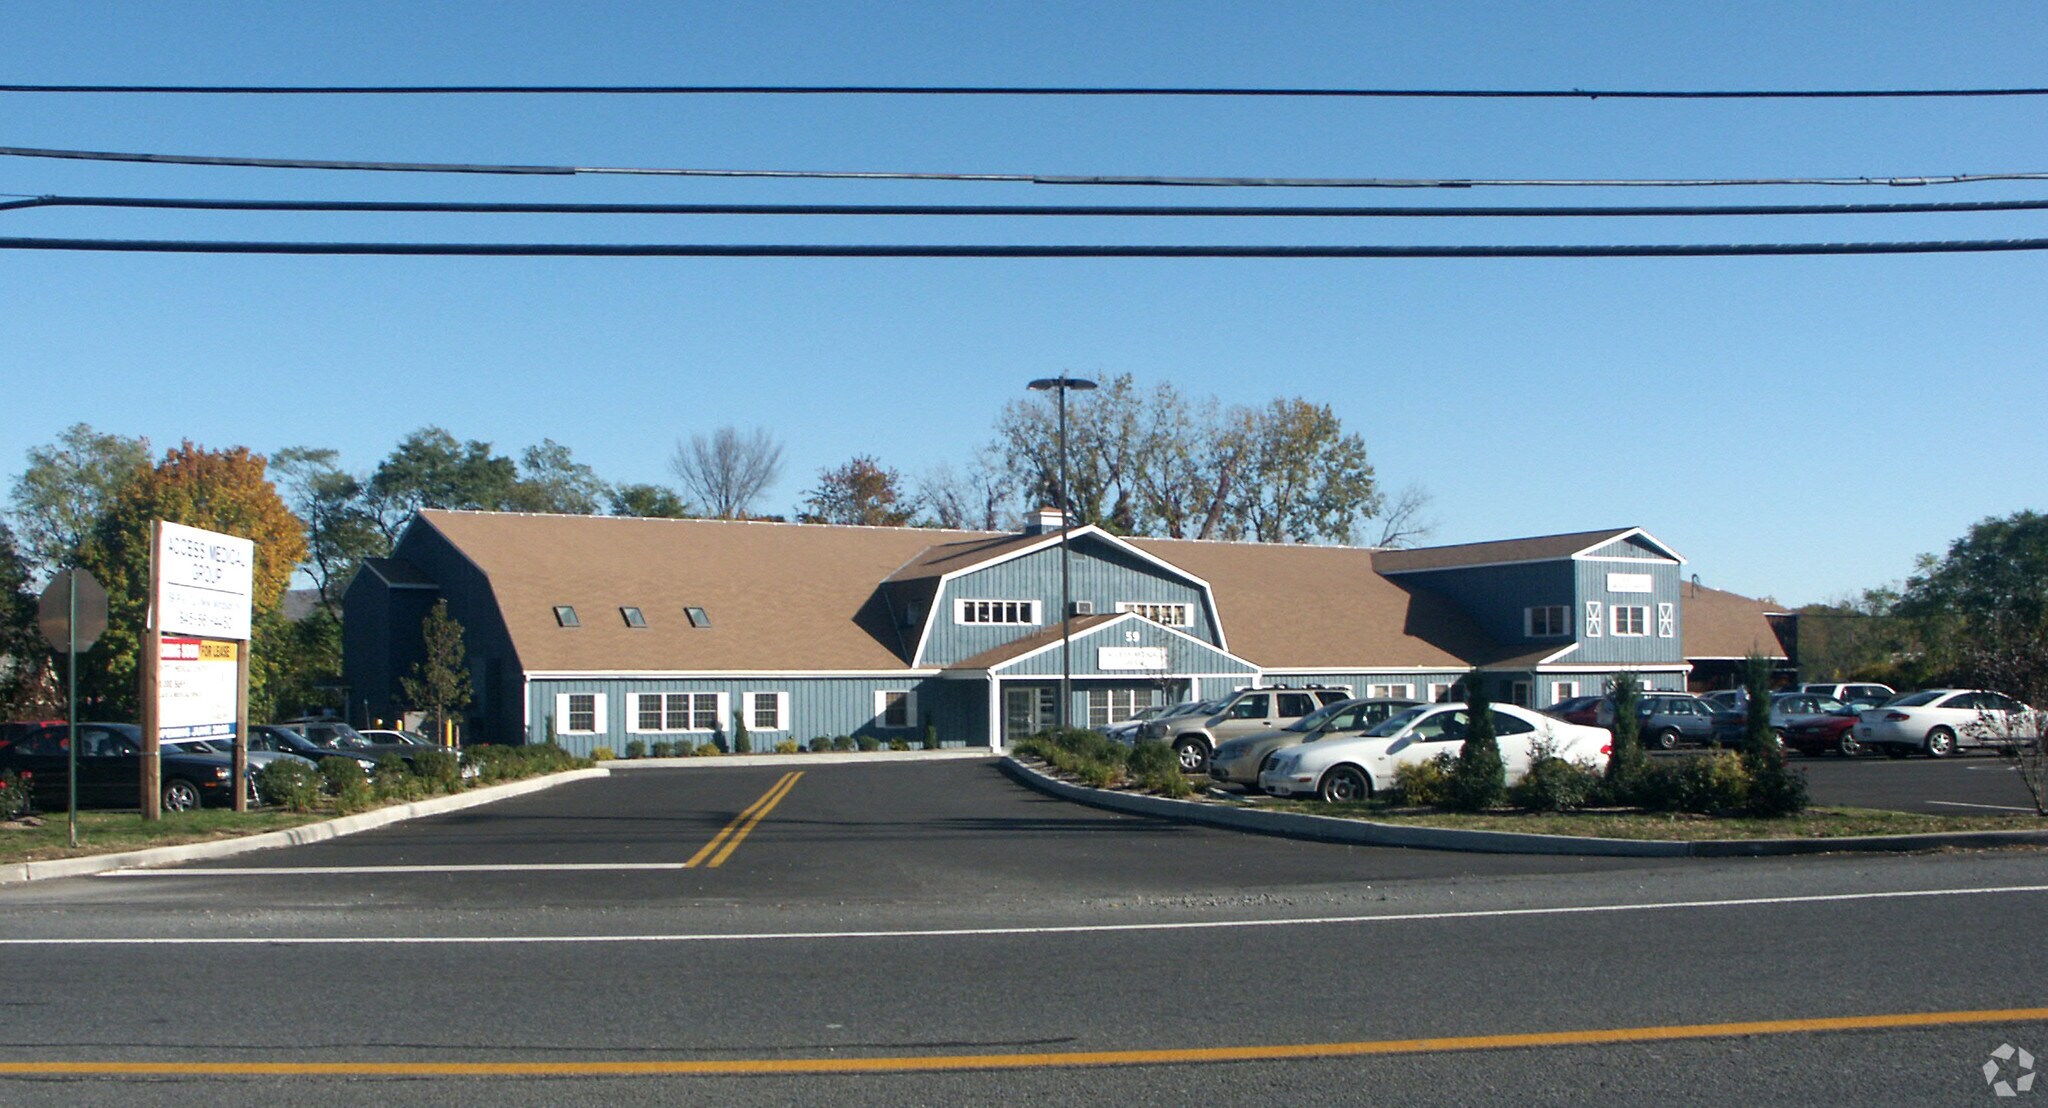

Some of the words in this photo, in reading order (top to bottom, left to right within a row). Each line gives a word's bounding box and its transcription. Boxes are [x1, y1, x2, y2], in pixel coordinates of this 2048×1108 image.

[168, 537, 205, 559] ACCESS
[209, 544, 245, 568] MEDICAL
[192, 562, 222, 584] GROUP
[1125, 631, 1141, 642] 59
[201, 645, 212, 658] FOR
[213, 645, 231, 659] LEASE
